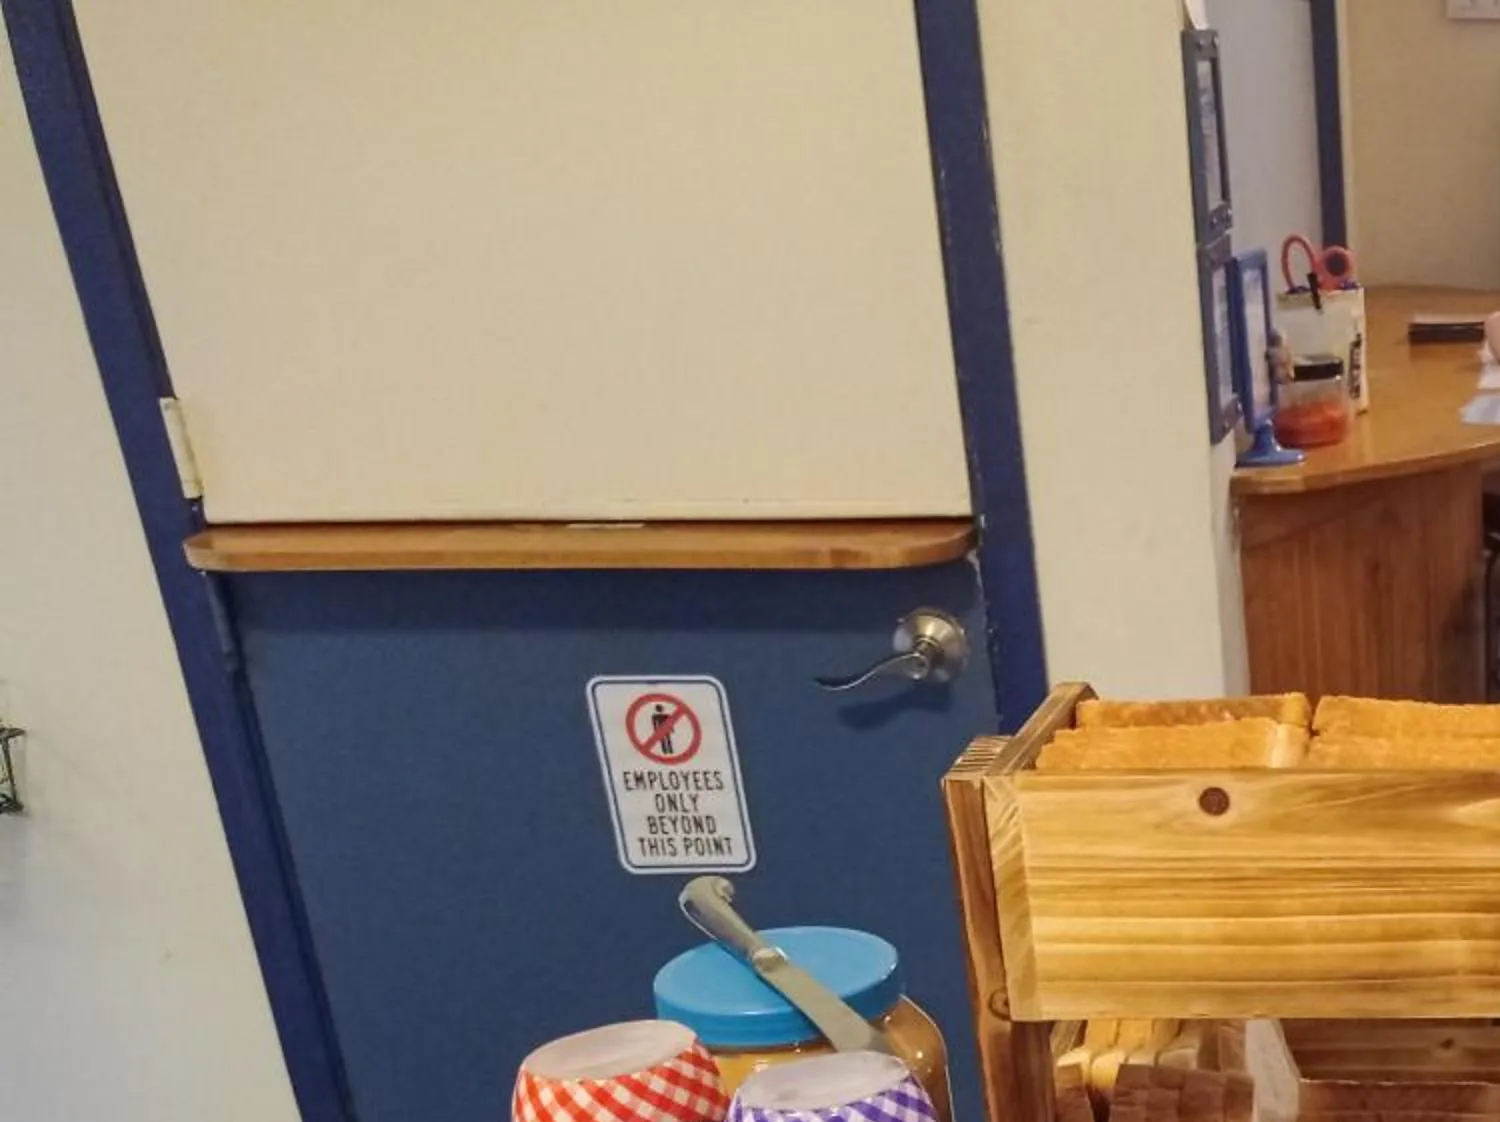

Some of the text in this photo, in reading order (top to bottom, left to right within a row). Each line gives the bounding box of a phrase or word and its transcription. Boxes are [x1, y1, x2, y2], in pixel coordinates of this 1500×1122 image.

[623, 771, 724, 791] EMPLOYEES
[655, 793, 699, 814] ONLY
[647, 815, 717, 835] BEYOND
[637, 837, 733, 856] THIS POINT
